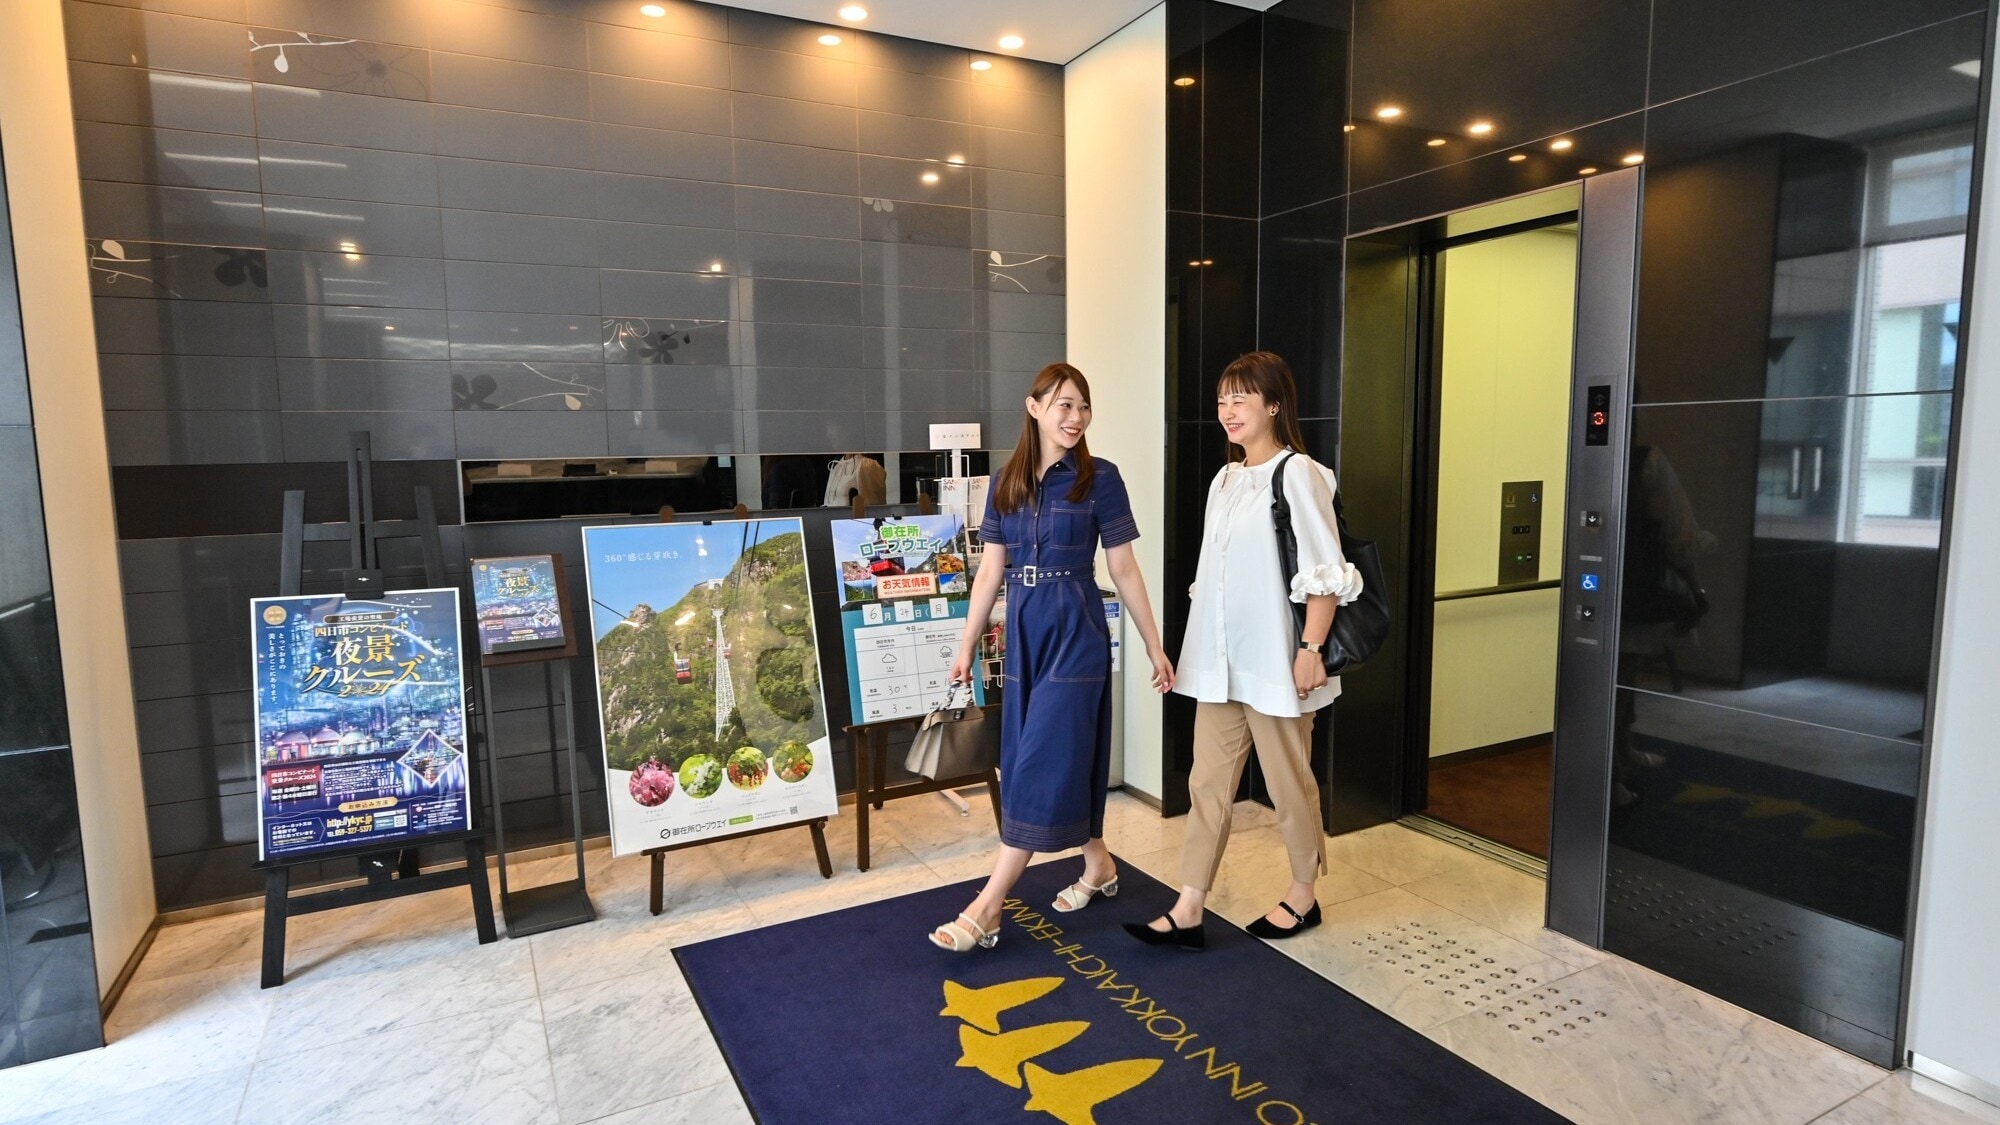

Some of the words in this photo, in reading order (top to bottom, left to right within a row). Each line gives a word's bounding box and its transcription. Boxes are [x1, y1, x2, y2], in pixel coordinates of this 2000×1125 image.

[1593, 411, 1604, 426] 3
[881, 527, 922, 540] 御在所
[882, 577, 931, 590] お天気情報
[314, 621, 408, 638] 四日市コンビナート
[328, 634, 395, 666] 夜景
[301, 653, 426, 694] クルーズ
[976, 889, 1199, 1053] YOKKAICHI-EKIM
[1184, 1046, 1269, 1101] INN
